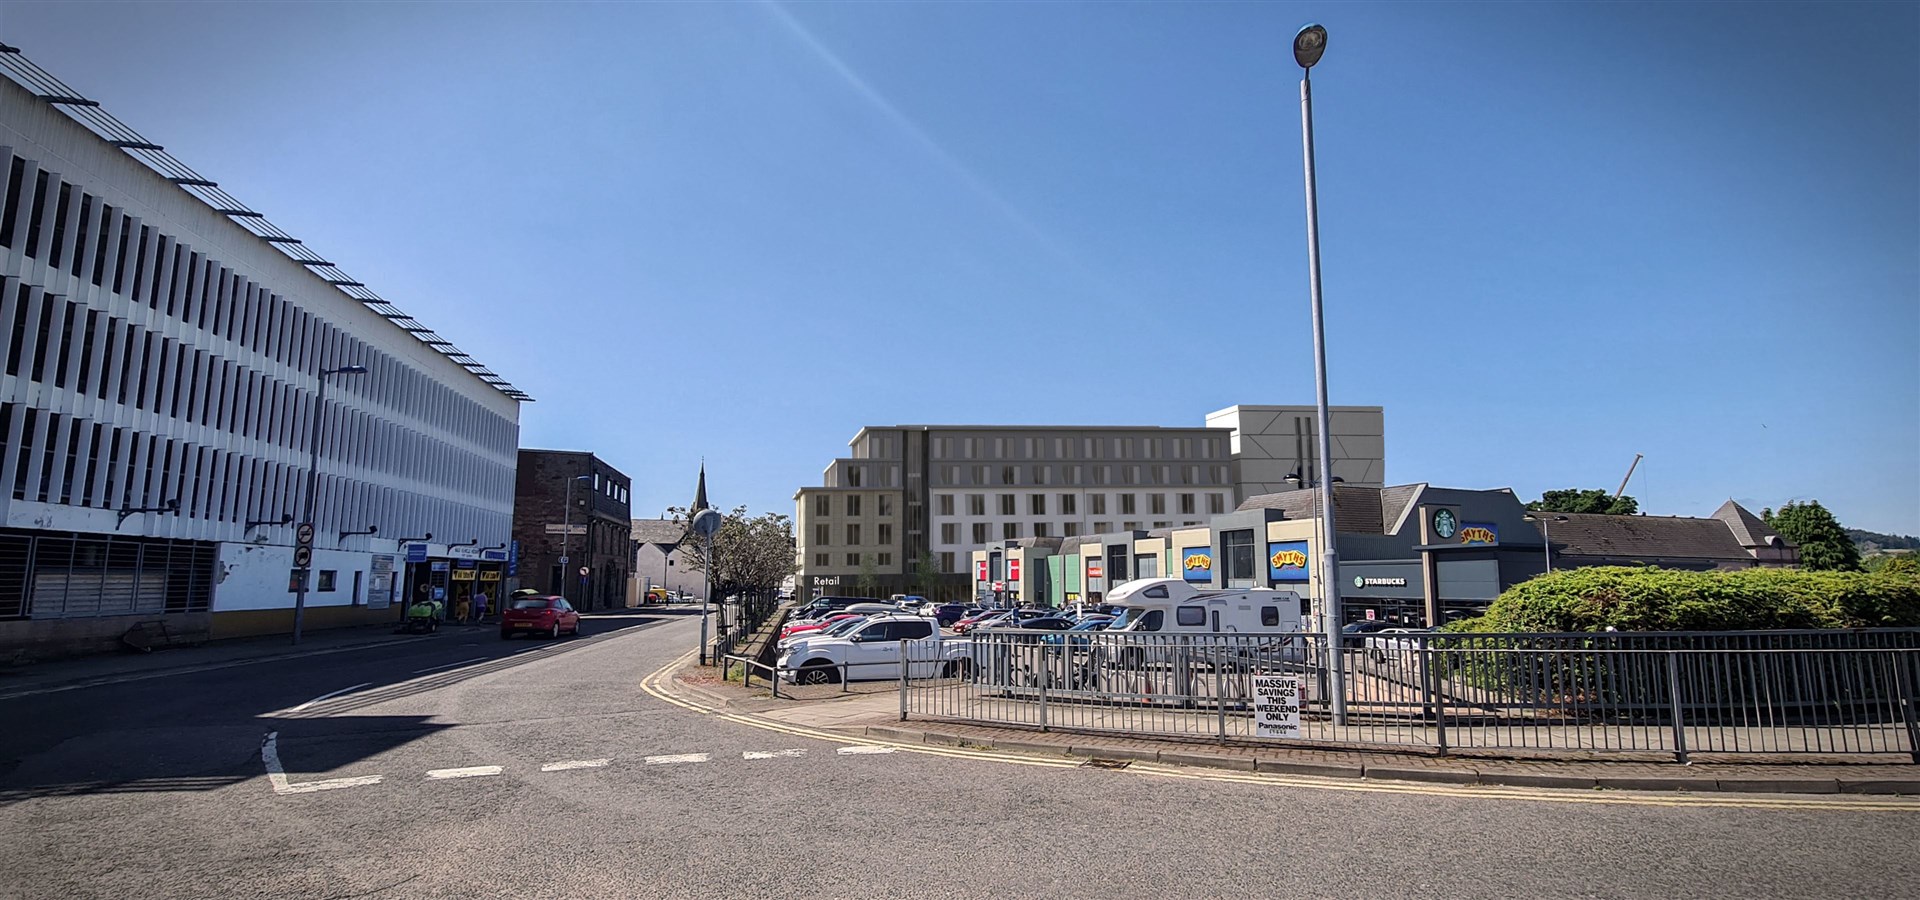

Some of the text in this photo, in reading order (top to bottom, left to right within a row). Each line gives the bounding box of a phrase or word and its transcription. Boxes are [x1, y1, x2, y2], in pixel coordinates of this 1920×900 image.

[1185, 556, 1209, 568] SMYTHS
[1272, 552, 1305, 567] SMYTHS
[814, 575, 840, 585] Retail
[1364, 577, 1406, 585] STARBUCKS
[1255, 679, 1297, 689] MASSIVE
[1257, 688, 1295, 697] SAVINGS
[1266, 697, 1287, 705] THIS
[1256, 704, 1298, 713] WEEKEND
[1265, 712, 1289, 721] ONLY
[1258, 722, 1297, 731] Panasonic
